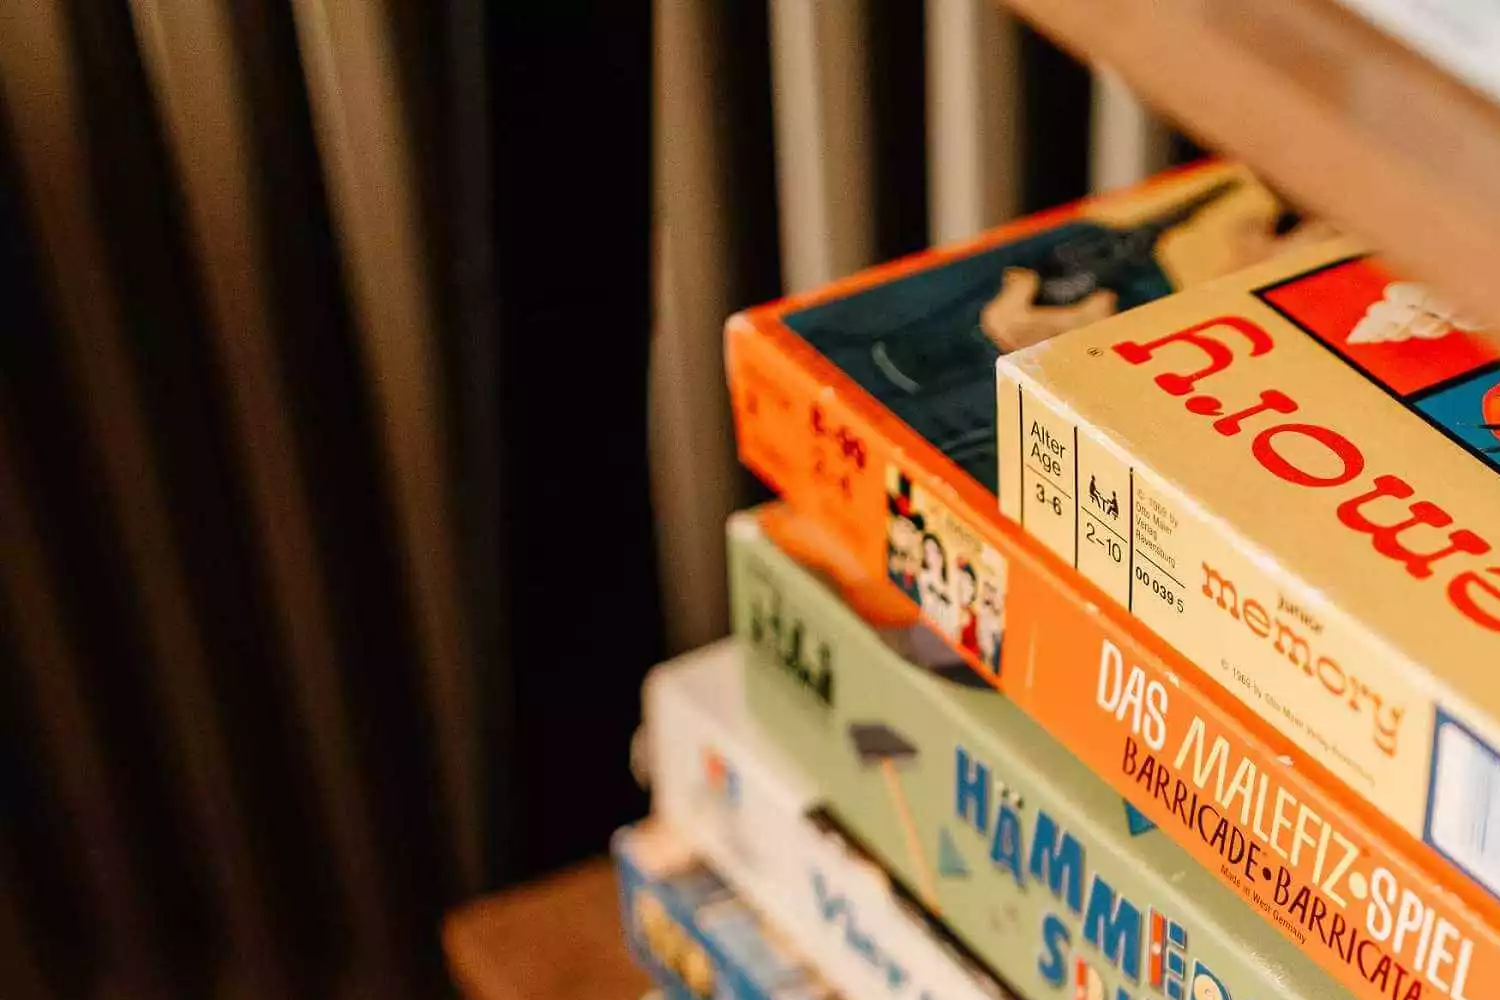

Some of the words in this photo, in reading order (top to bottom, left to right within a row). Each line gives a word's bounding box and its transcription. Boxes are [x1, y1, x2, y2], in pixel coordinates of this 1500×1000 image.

[1030, 420, 1067, 460] Alter
[1030, 442, 1062, 477] Age
[1096, 638, 1169, 752] DAS
[1202, 560, 1407, 759] memory
[1219, 863, 1242, 889] Made
[1253, 891, 1272, 914] West
[1272, 909, 1308, 946] Germany
